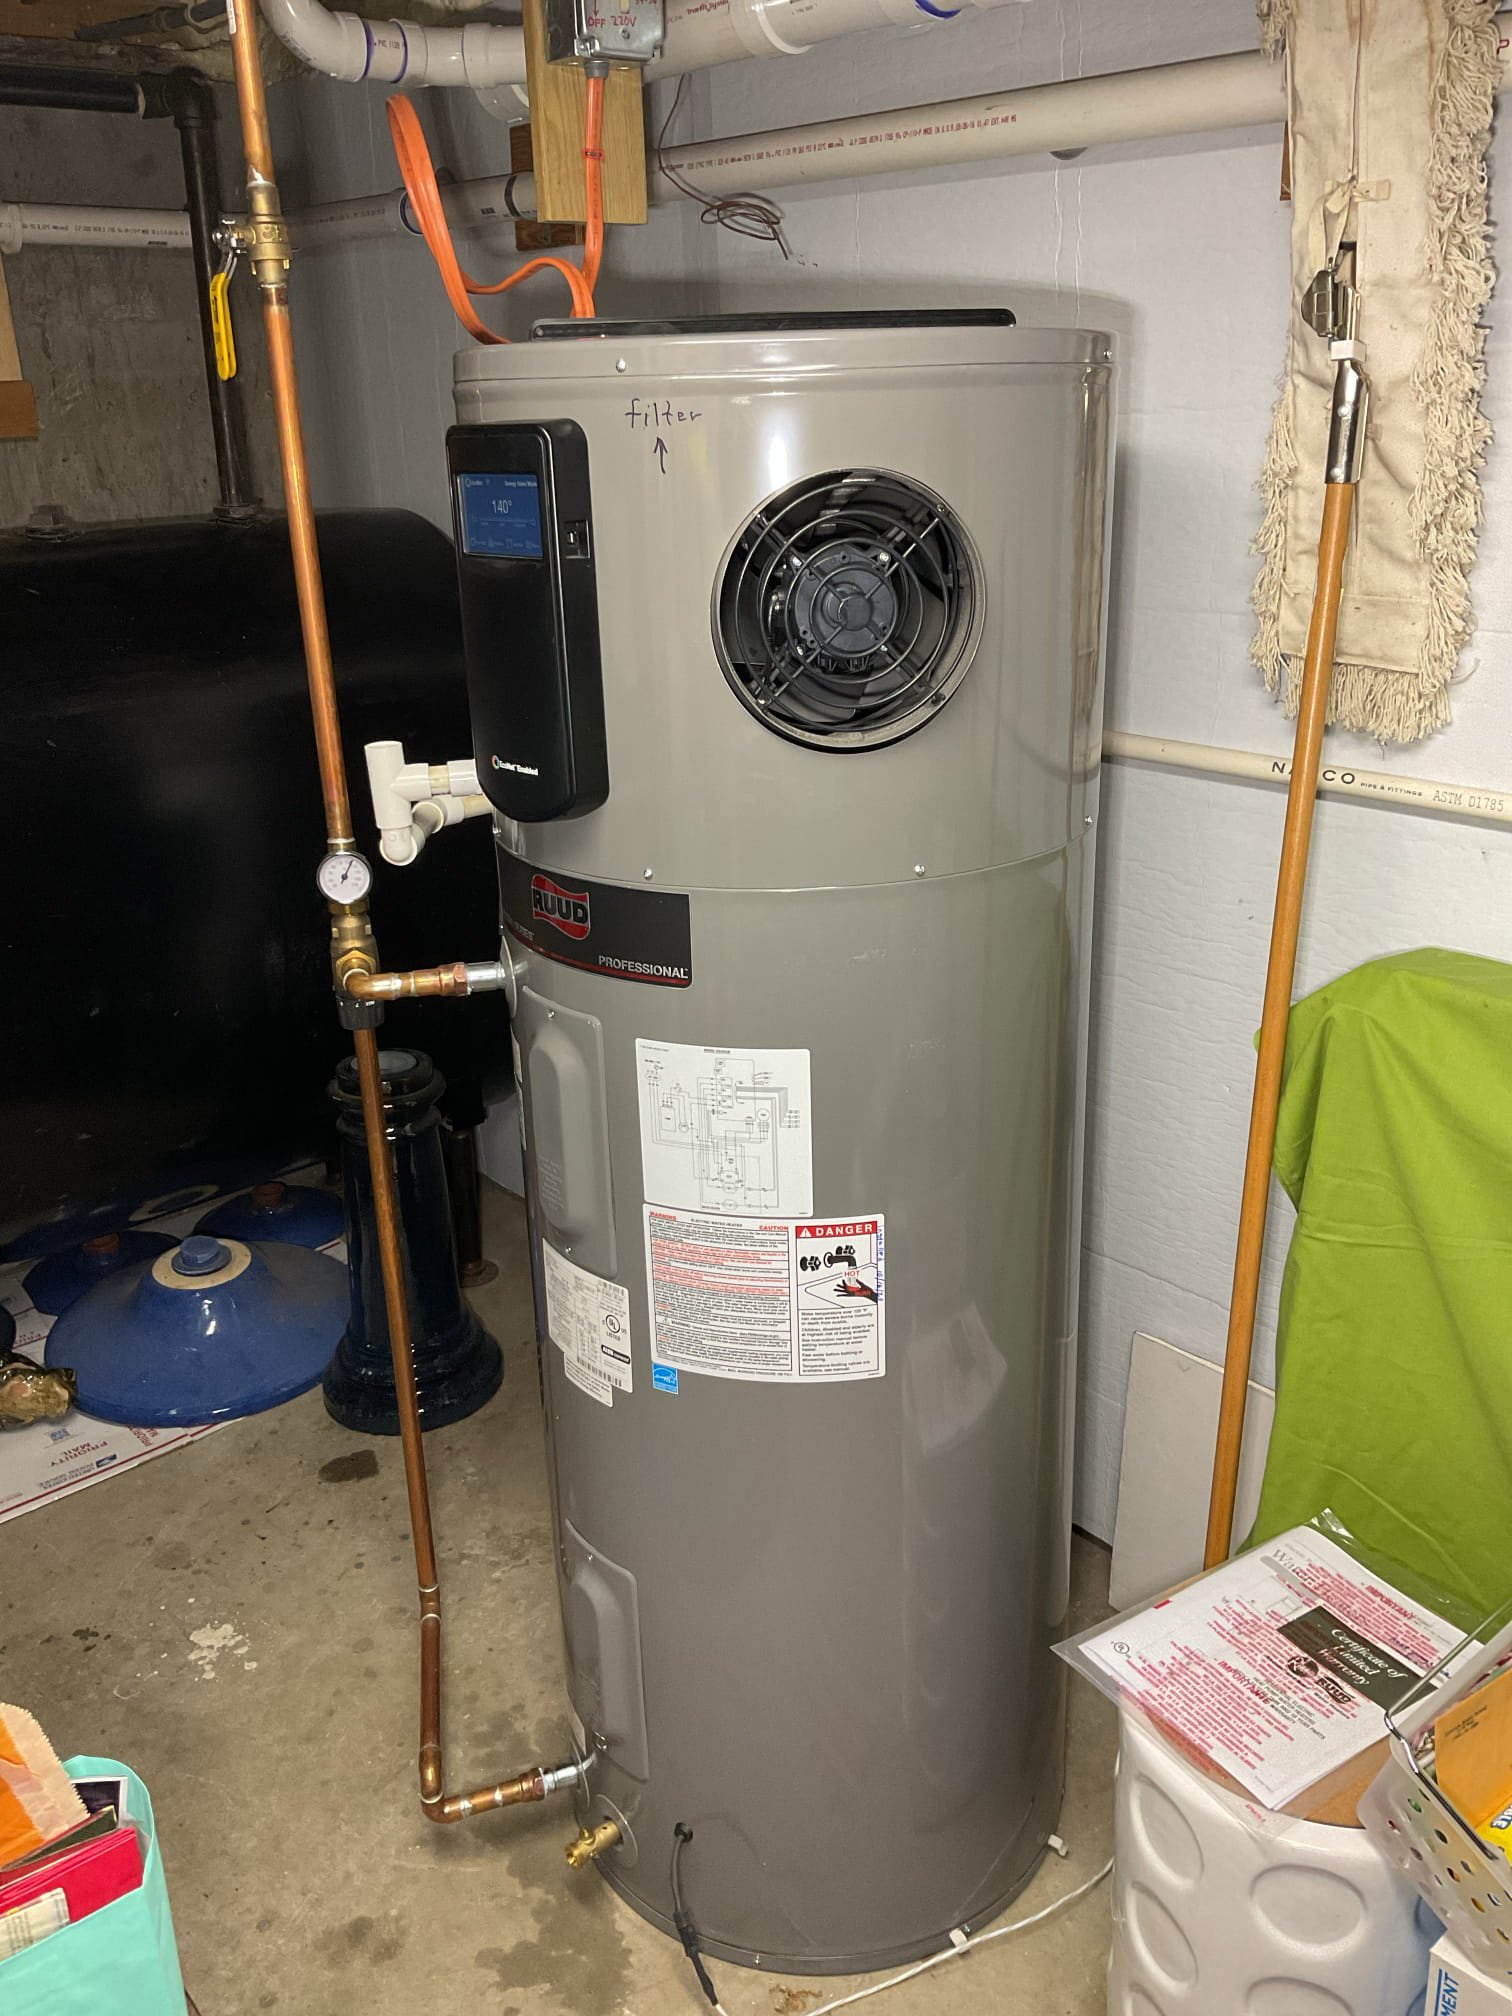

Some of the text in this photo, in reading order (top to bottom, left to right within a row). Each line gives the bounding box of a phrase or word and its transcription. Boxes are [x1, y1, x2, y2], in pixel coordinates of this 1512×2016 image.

[587, 15, 637, 28] OFF 220V
[625, 398, 702, 430] filter
[1360, 782, 1377, 790] PIPE
[1387, 786, 1423, 797] FITTINGS
[1432, 790, 1462, 806] ASTM
[1468, 795, 1505, 812] D1785
[533, 887, 589, 924] RUUD
[598, 955, 689, 979] PROFESSIONAL
[815, 1224, 873, 1237] DANGER
[49, 1440, 107, 1467] PRIORITY
[1331, 1628, 1408, 1680] Certificate of
[1332, 1644, 1381, 1674] Limited
[1217, 1660, 1272, 1705] IMPORTANTE
[1316, 1677, 1352, 1703] RUUD
